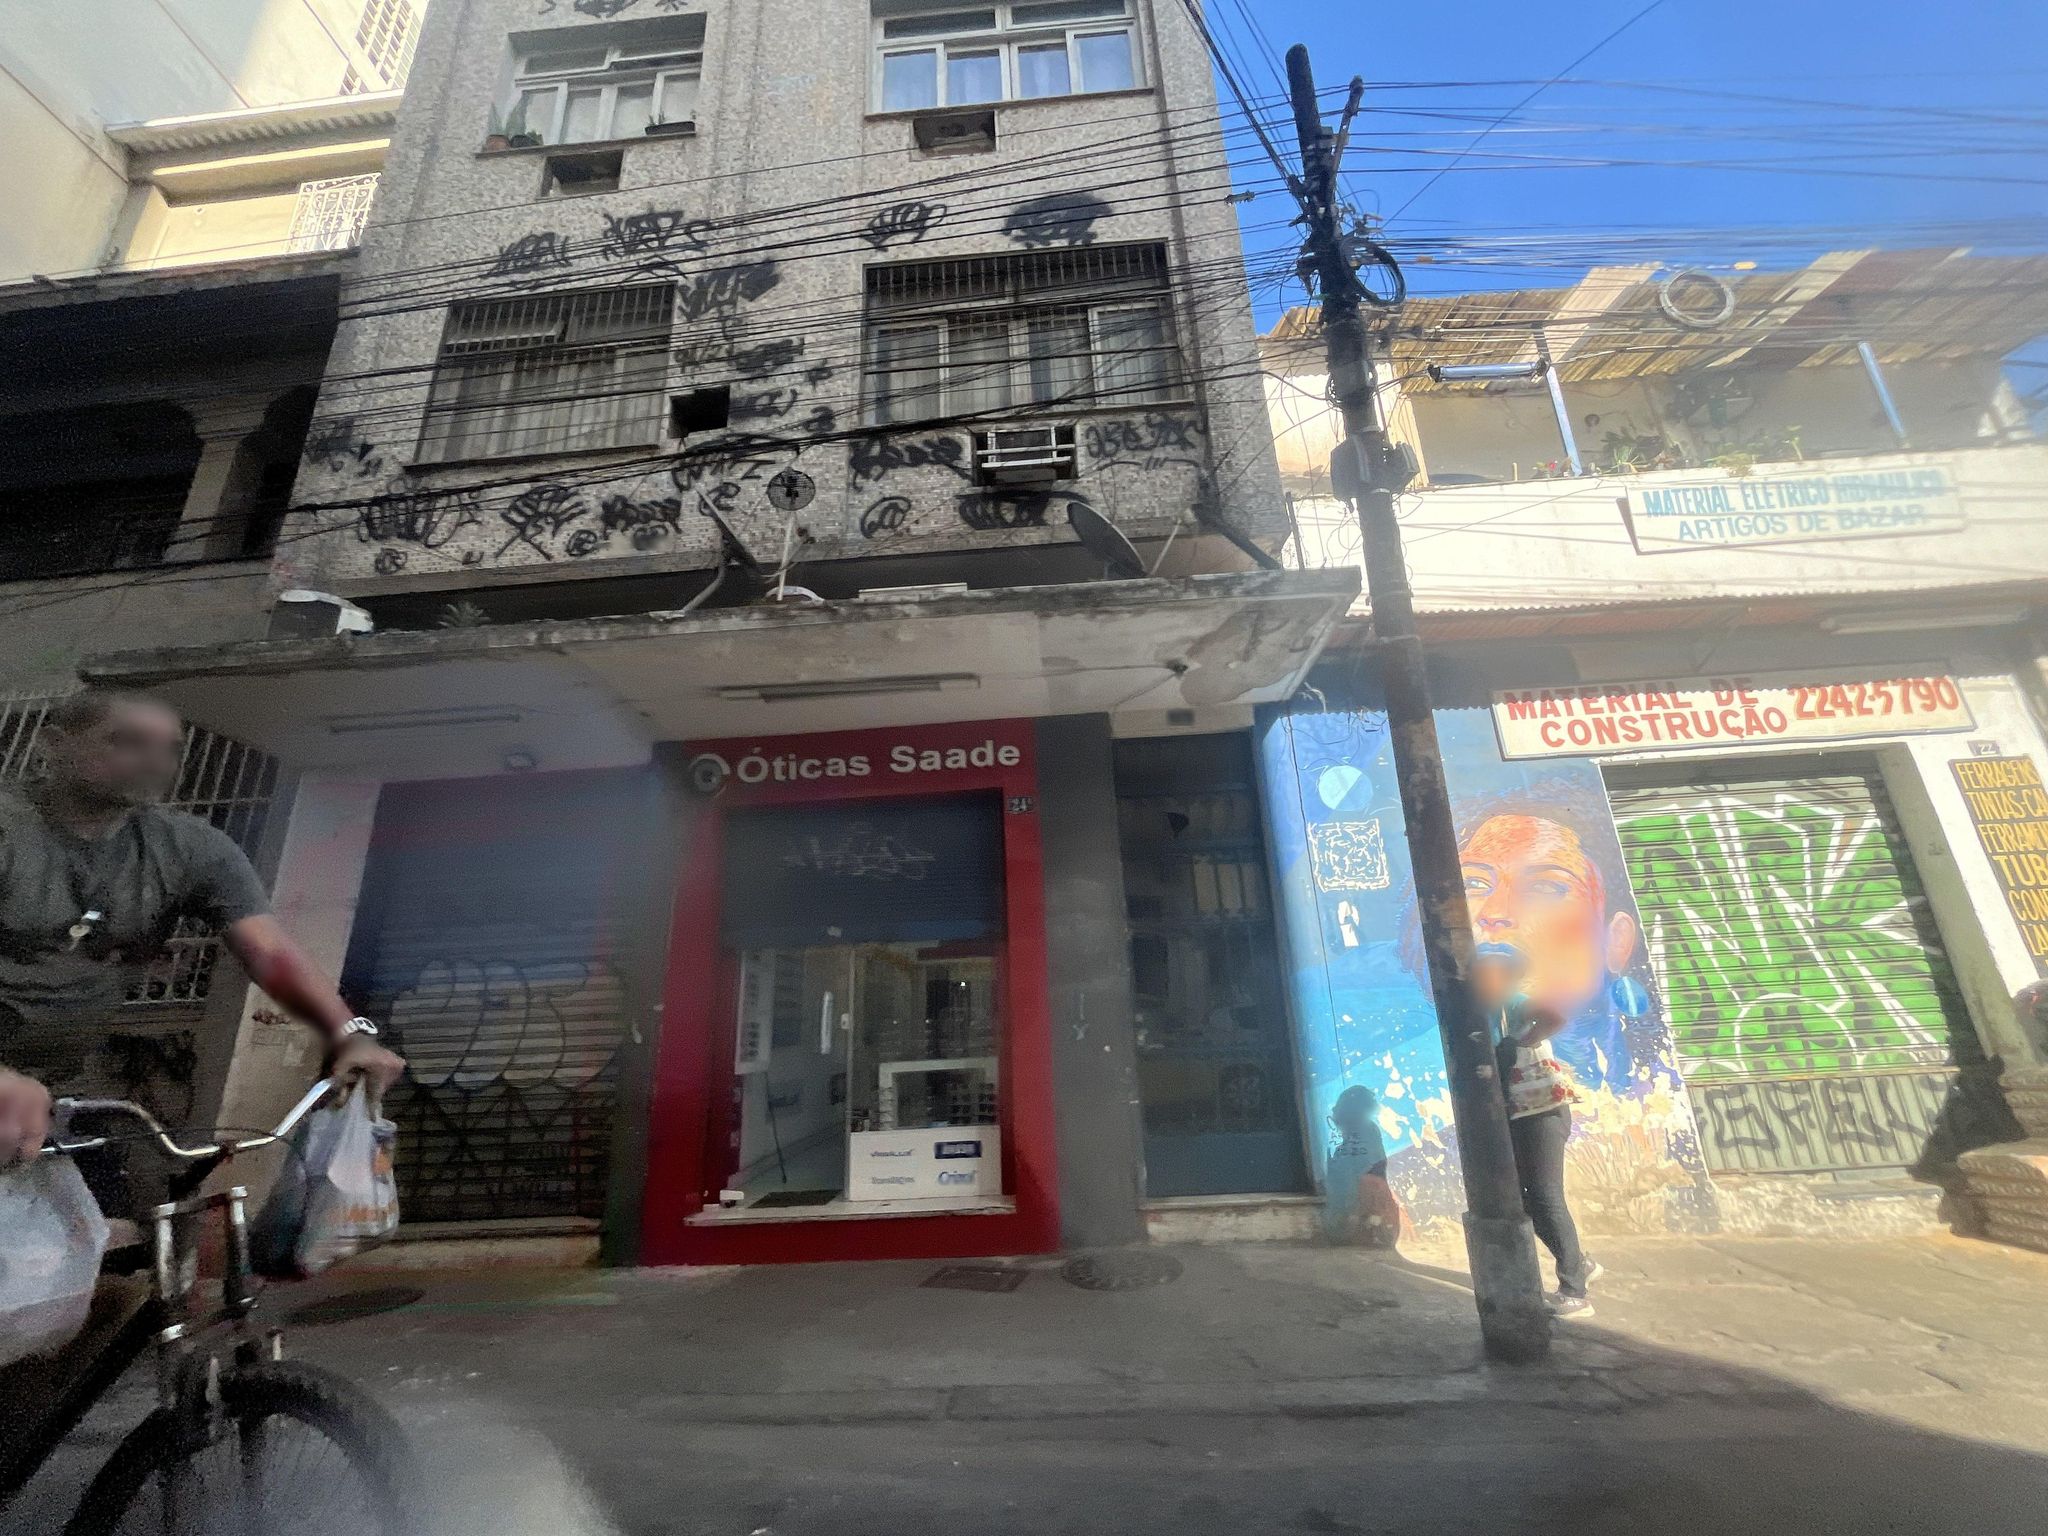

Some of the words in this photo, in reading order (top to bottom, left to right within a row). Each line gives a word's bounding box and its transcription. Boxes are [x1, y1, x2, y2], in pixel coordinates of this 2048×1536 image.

[1642, 485, 1735, 517] MATERIAL
[1679, 514, 1788, 541] ARTIGOS
[1796, 510, 1831, 533] DE
[1838, 504, 1928, 530] BAZAR
[1504, 680, 1692, 720] MATERIAL
[1709, 677, 1759, 707] DE
[1540, 704, 1787, 748] CONSTRUÇÃO
[737, 746, 872, 783] Óticas
[889, 739, 1021, 773] Saade
[1955, 759, 2041, 789] FERRAGENS
[1992, 853, 2048, 886] TUB
